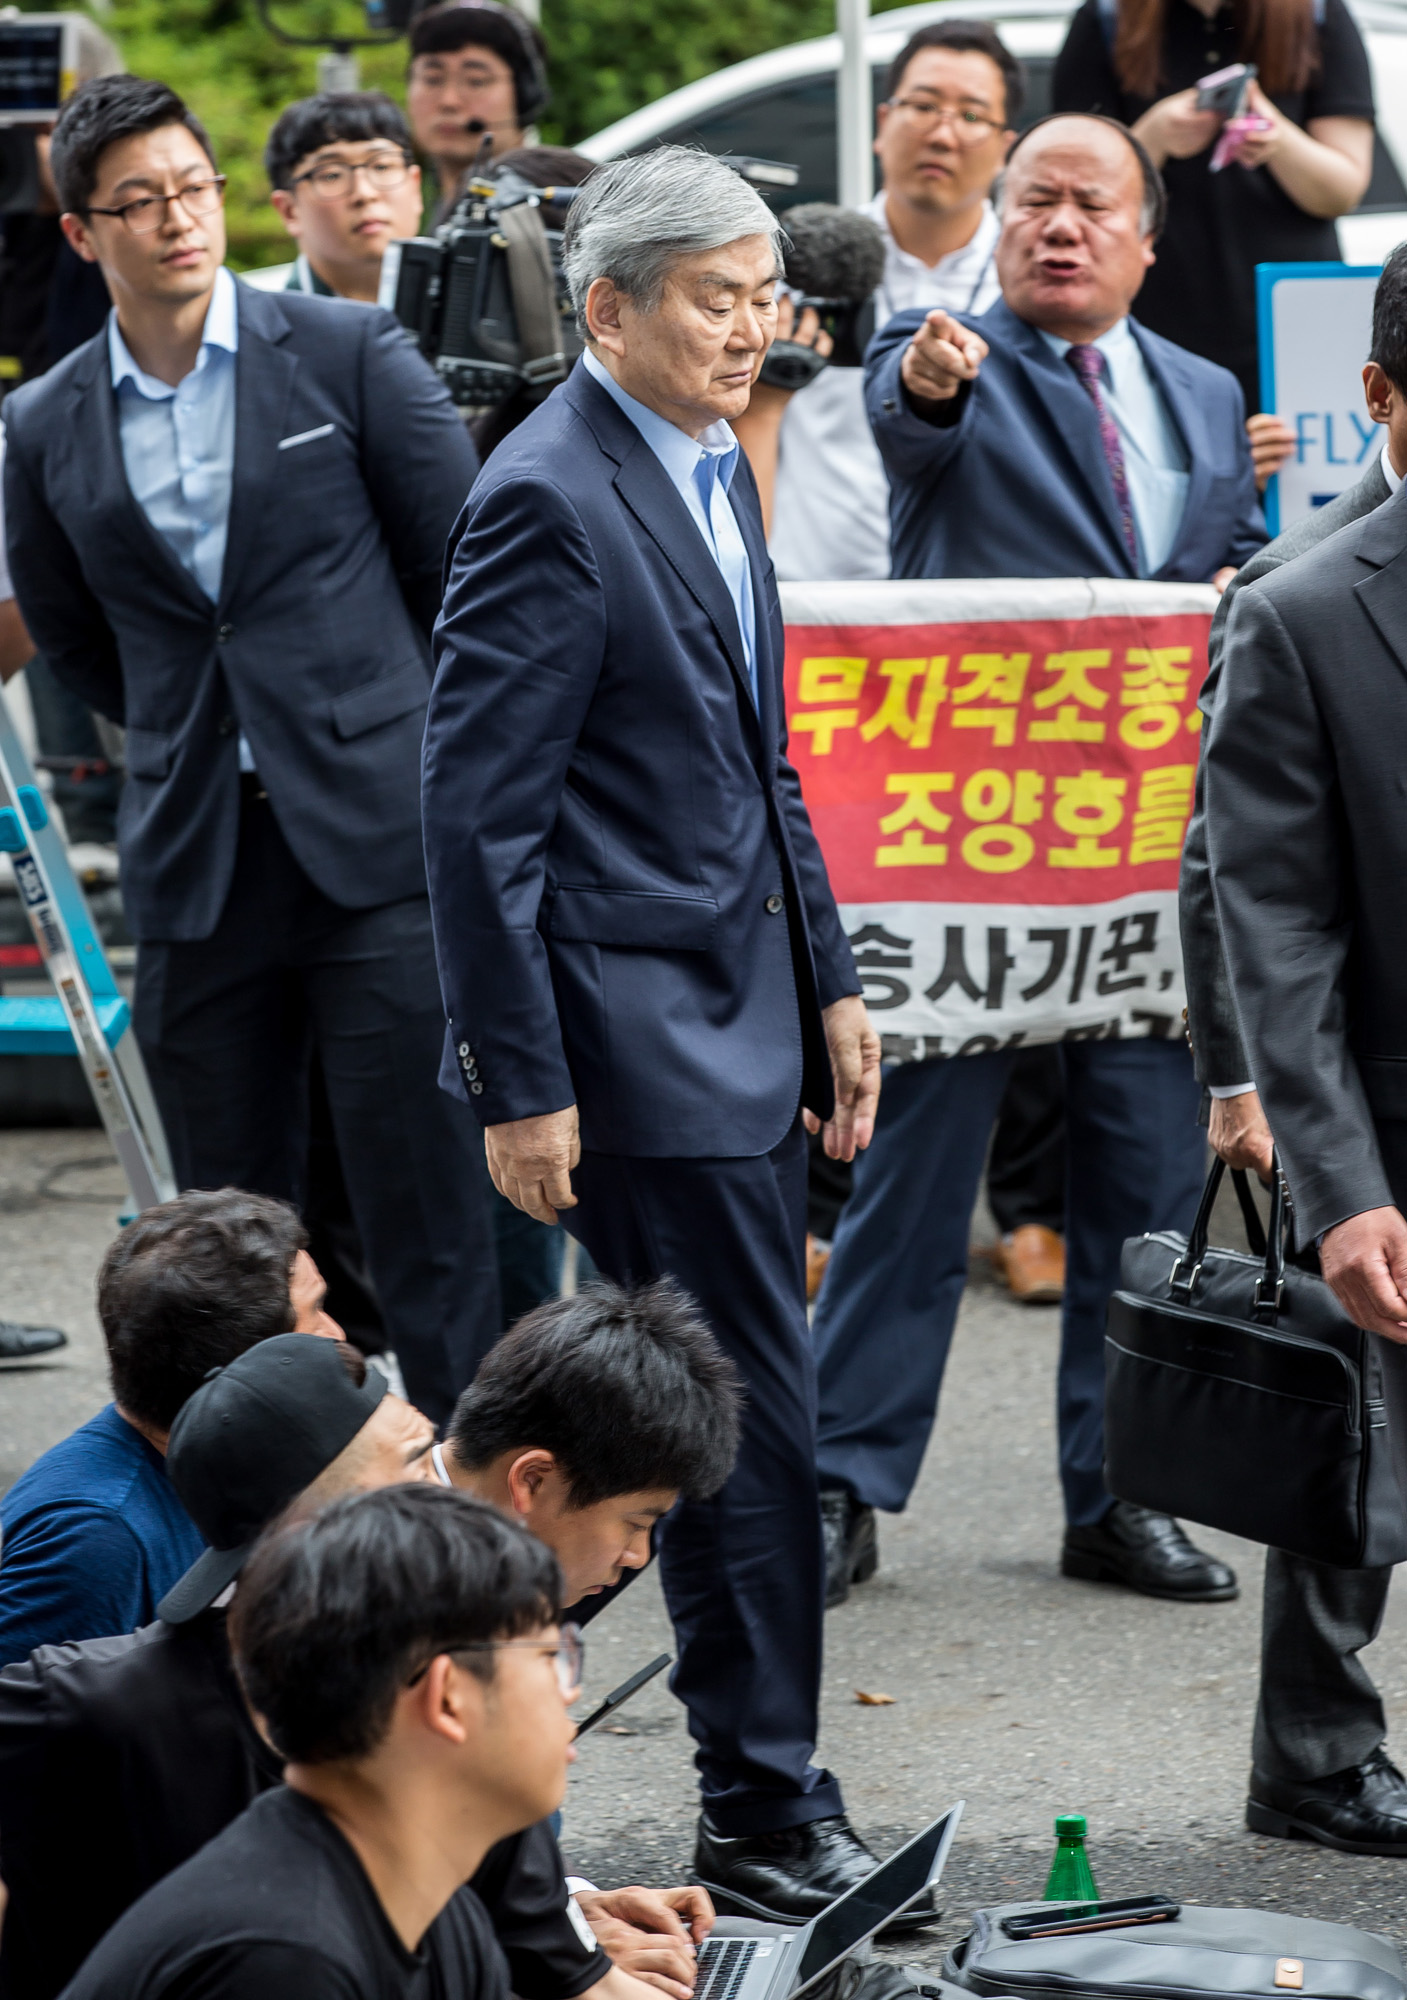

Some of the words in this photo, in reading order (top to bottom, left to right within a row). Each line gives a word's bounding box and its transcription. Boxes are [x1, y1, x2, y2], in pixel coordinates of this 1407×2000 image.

[1296, 411, 1380, 465] FLY
[791, 646, 1203, 756] 무자격조종
[875, 764, 1196, 873] 조양호를
